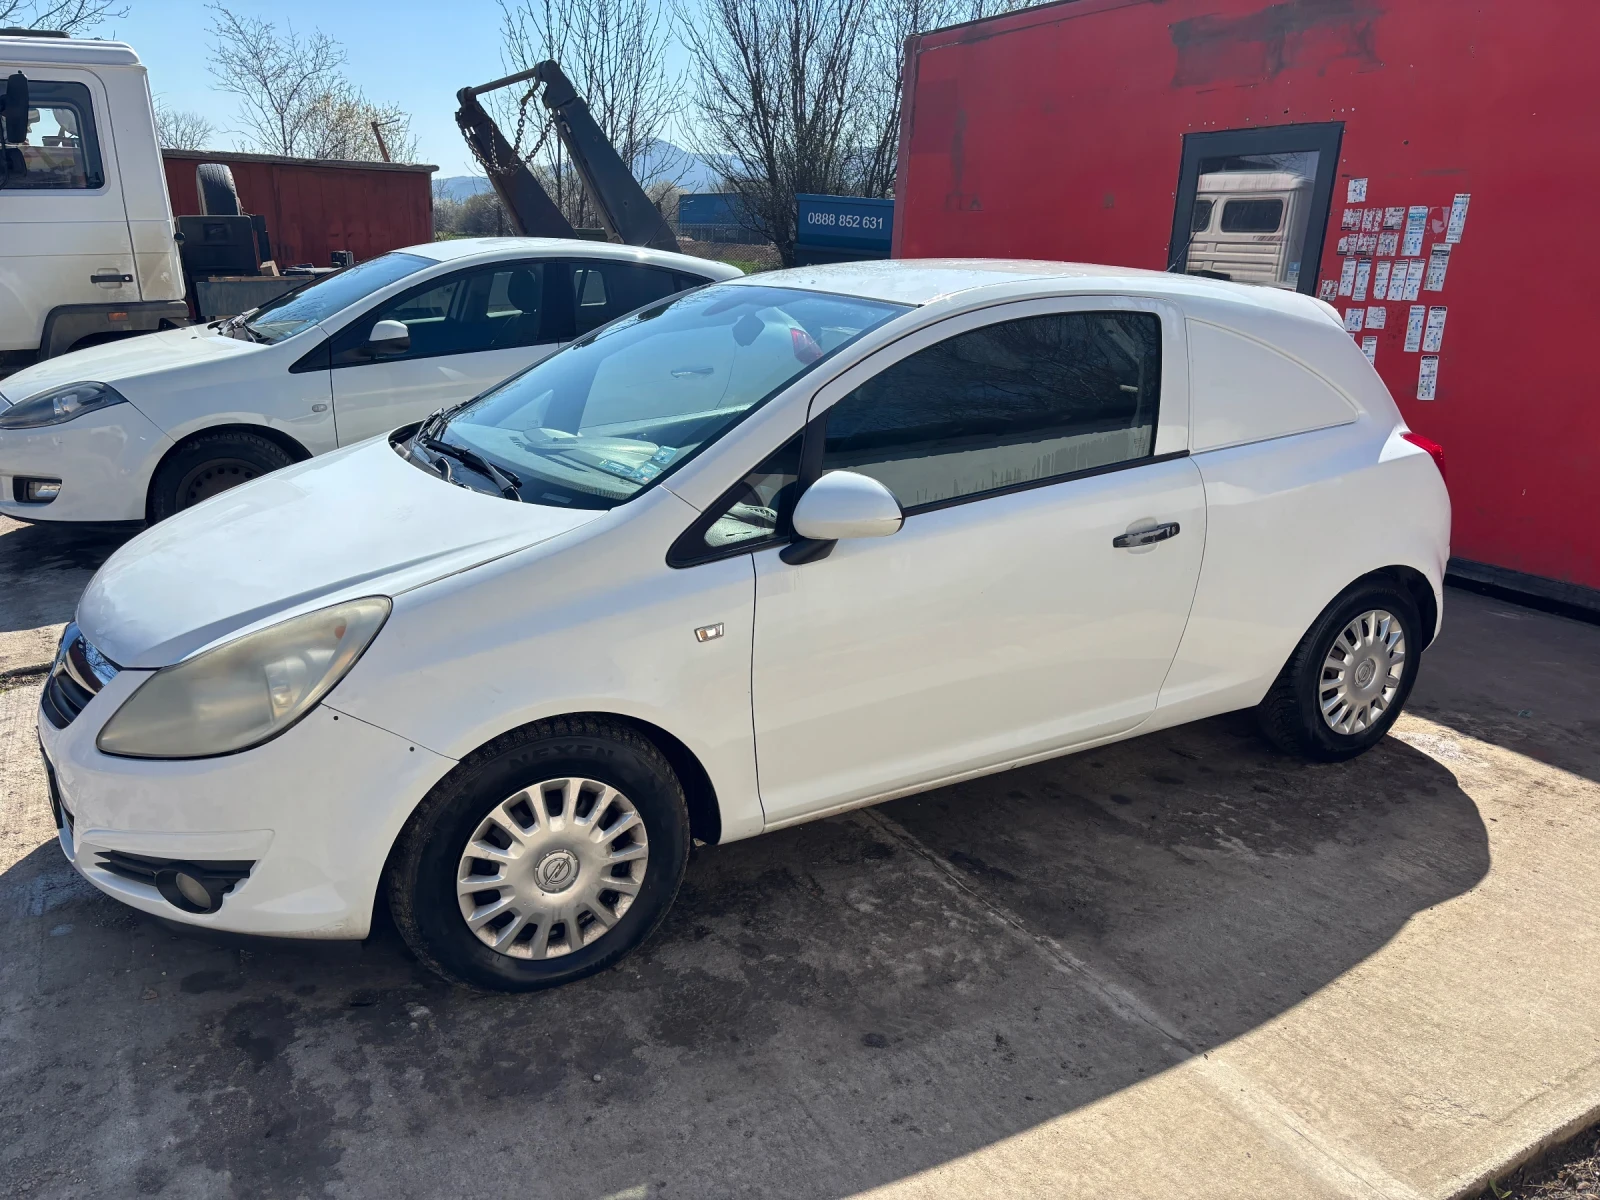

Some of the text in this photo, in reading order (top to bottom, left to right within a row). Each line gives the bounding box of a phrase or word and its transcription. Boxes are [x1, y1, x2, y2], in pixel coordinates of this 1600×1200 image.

[808, 212, 883, 230] 0888 852 631
[508, 744, 615, 770] NEXEN
